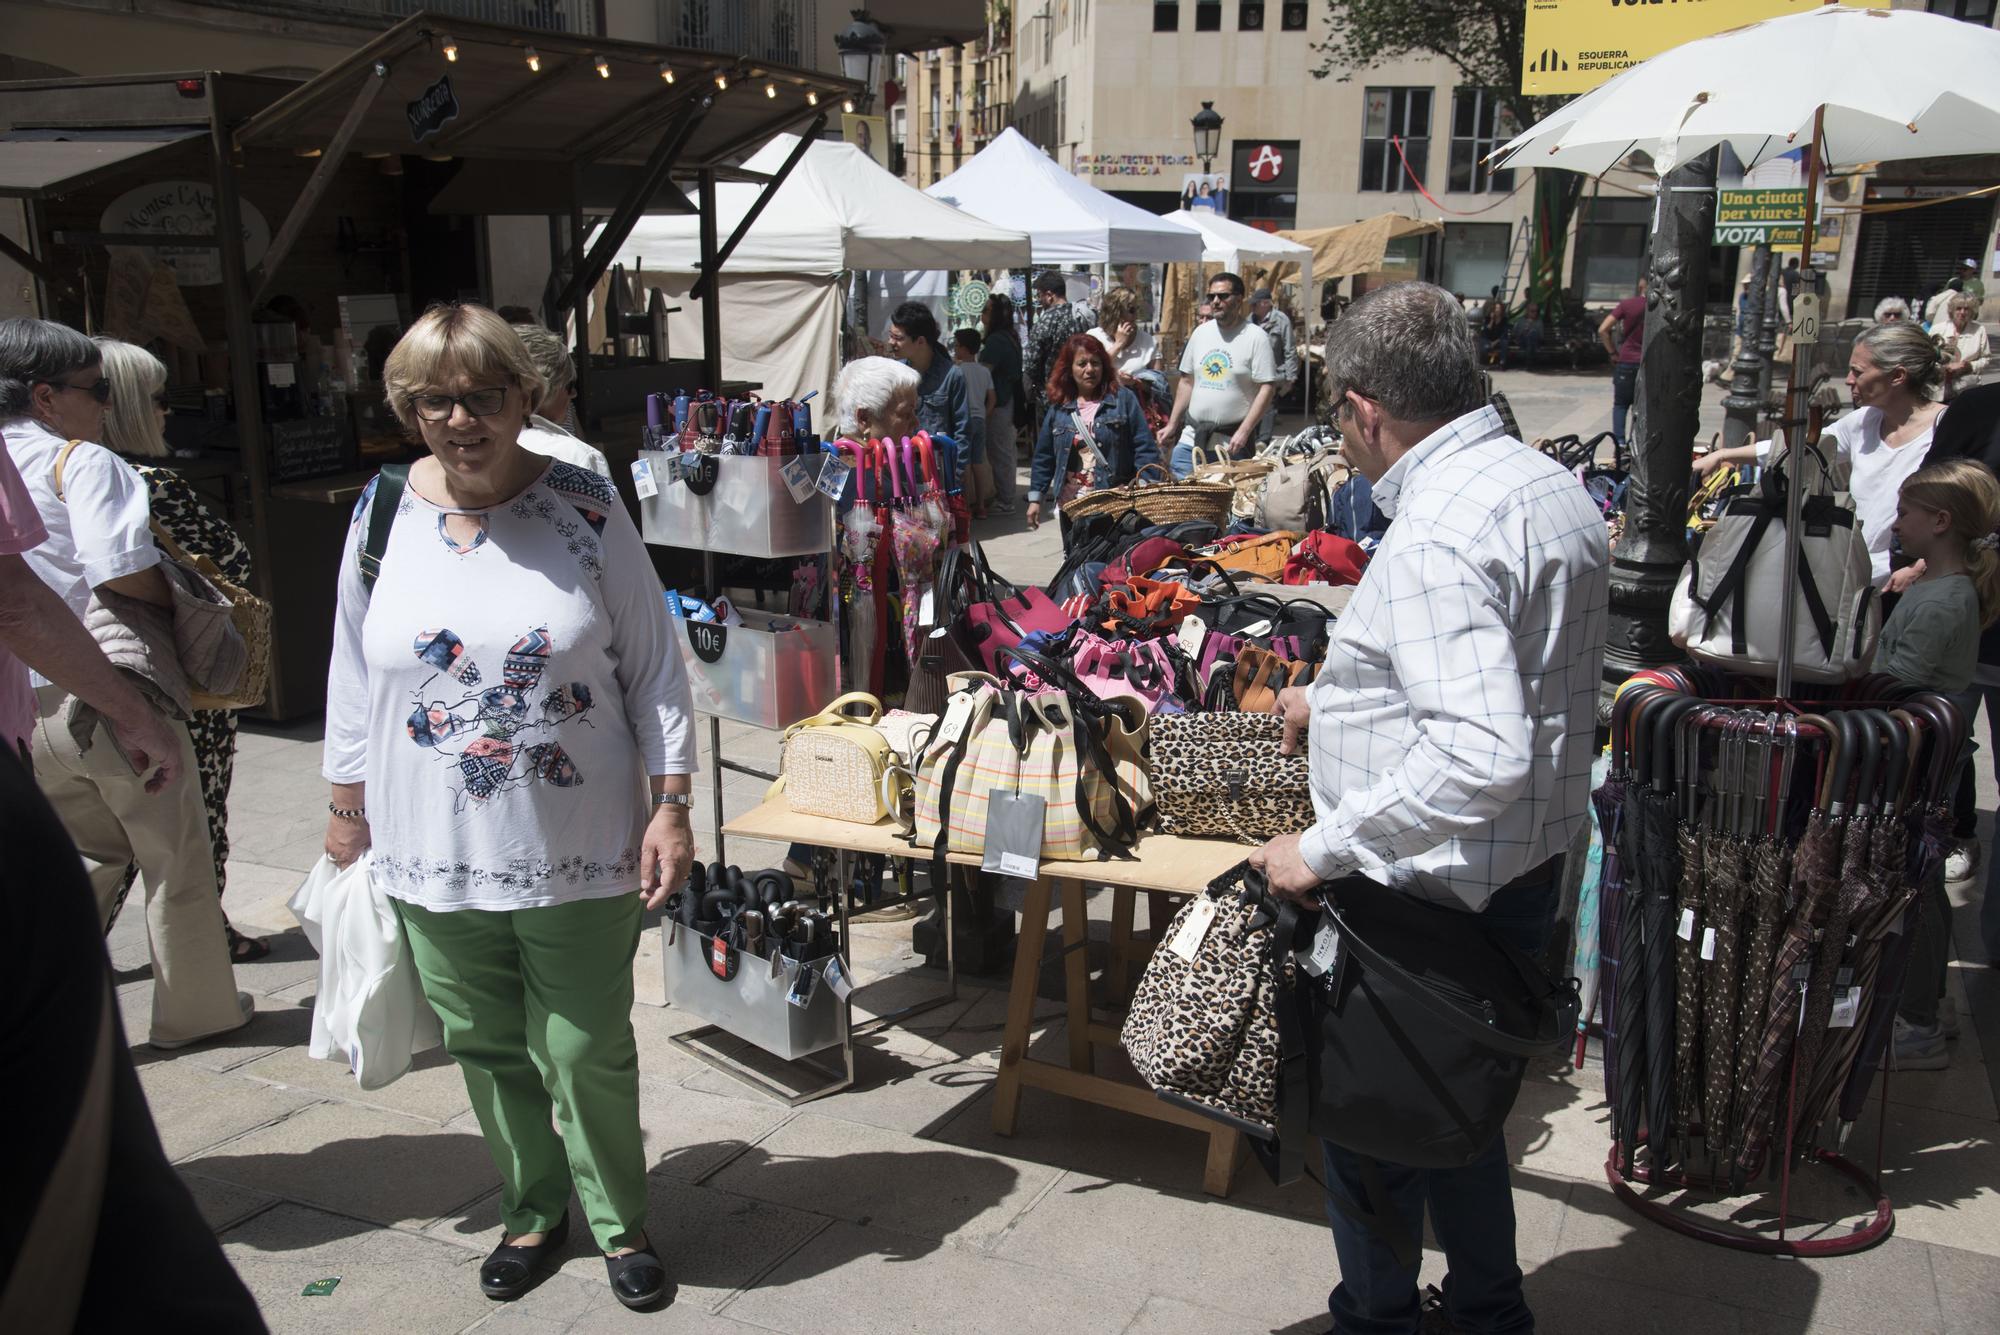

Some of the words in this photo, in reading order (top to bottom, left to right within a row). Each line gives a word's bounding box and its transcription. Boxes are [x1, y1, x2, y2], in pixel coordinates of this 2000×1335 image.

[1578, 50, 1629, 60] ESQUERRA
[1577, 60, 1646, 71] REPUBLICAN
[1093, 155, 1154, 165] ARQUITECTES
[1107, 166, 1161, 176] BARCELONA
[1722, 192, 1753, 205] Una
[1756, 190, 1804, 204] ciutat
[1720, 208, 1747, 222] per
[1750, 205, 1808, 220] viure-h
[1715, 228, 1766, 244] VOTA
[695, 626, 720, 653] 10€
[943, 722, 959, 737] 69
